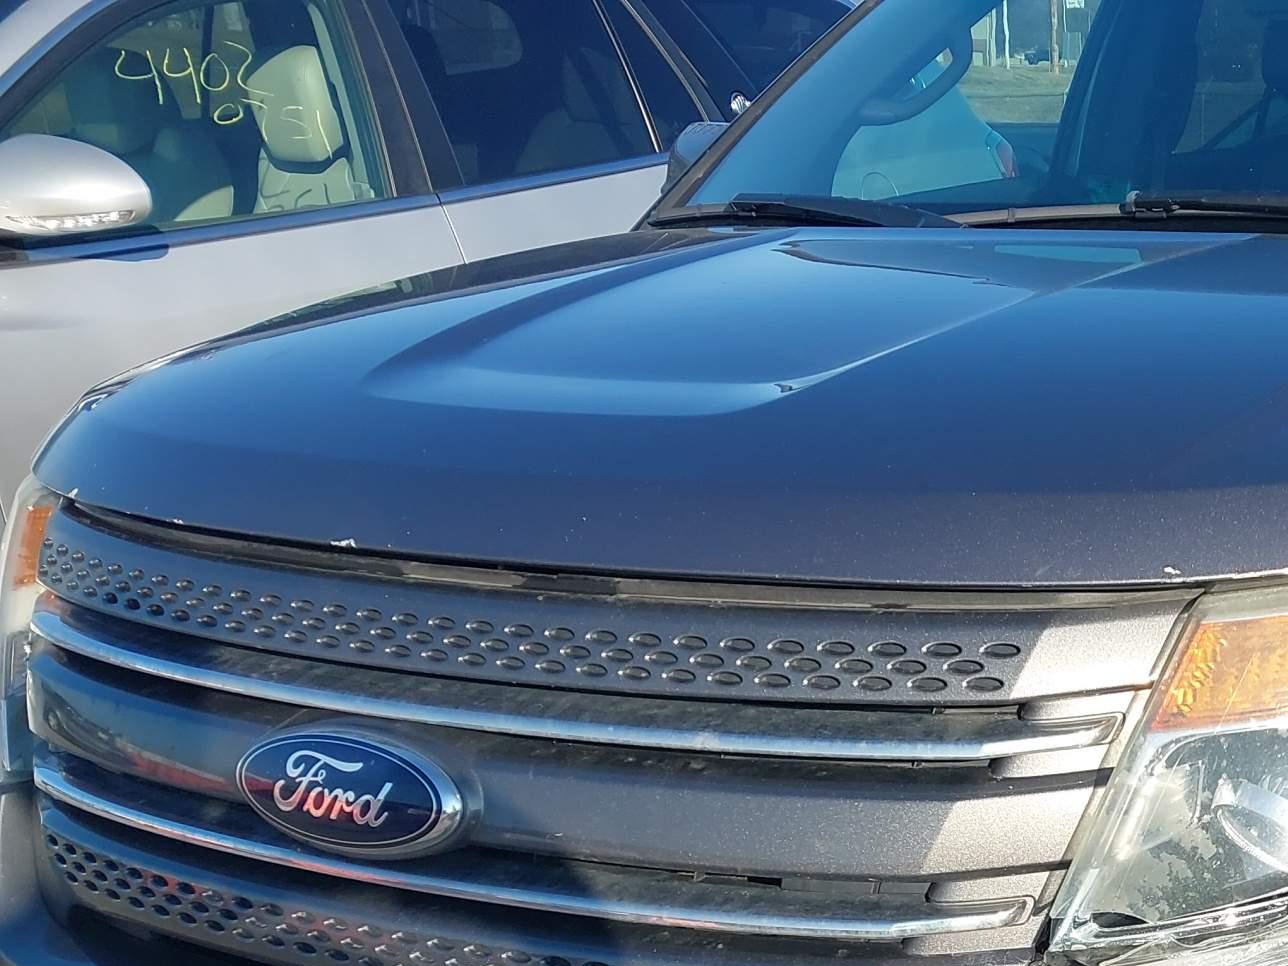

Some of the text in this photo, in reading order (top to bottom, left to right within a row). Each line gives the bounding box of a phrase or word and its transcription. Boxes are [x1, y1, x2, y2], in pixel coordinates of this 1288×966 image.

[115, 41, 275, 105] 4402
[213, 98, 333, 160] 0751
[273, 749, 393, 829] Ford
